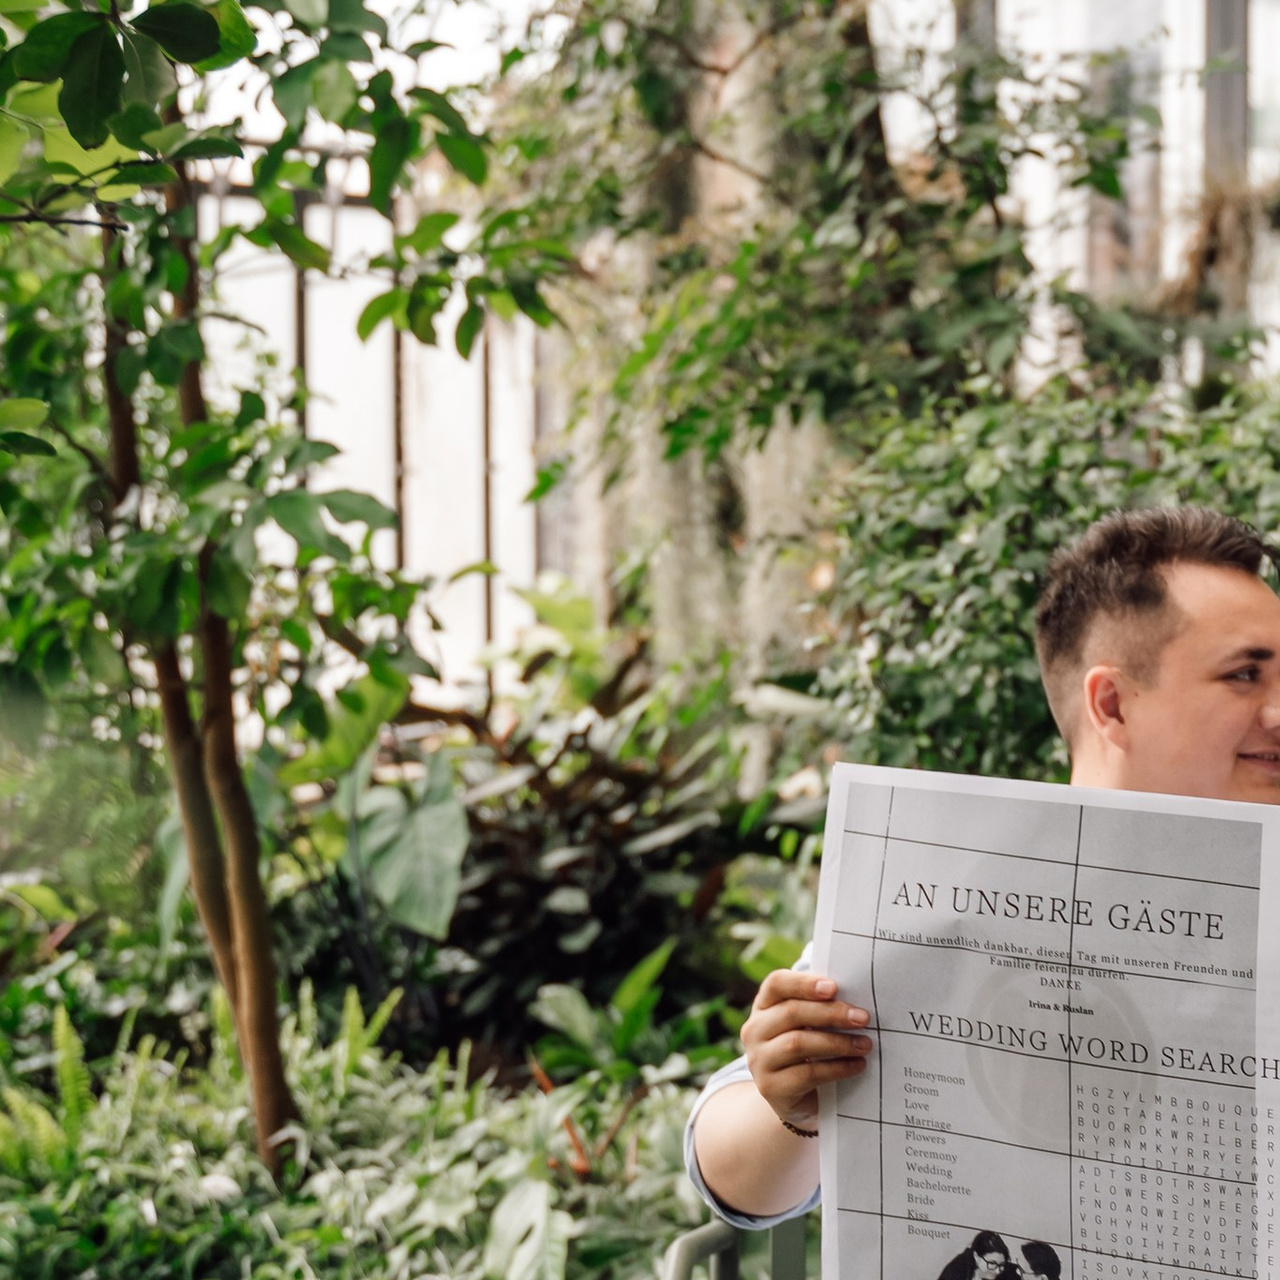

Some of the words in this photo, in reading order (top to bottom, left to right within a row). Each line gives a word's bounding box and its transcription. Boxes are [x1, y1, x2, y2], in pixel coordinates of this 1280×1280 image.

[891, 881, 938, 909] AN
[952, 886, 1093, 926] UNSERE
[1107, 899, 1225, 940] GÄSTE
[878, 928, 897, 941] Wir
[900, 932, 922, 944] sind
[926, 935, 980, 949] unendlich
[984, 940, 1033, 956] dankbar,
[1077, 950, 1097, 964] Tag
[1101, 954, 1120, 965] mit
[1124, 958, 1169, 970] unseren
[1173, 961, 1228, 977] Freunden
[1232, 968, 1254, 980] und
[989, 955, 1032, 970] Familie
[1040, 976, 1082, 991] DANKE
[1029, 1000, 1051, 1011] Irina
[1053, 1003, 1061, 1012] &
[1062, 1002, 1094, 1016] Ruslan
[908, 1011, 1048, 1052] WEDDING
[1058, 1033, 1149, 1064] WORD
[903, 1066, 966, 1086] Honeymoon
[903, 1082, 940, 1097] Groom
[904, 1098, 930, 1111] Love
[904, 1114, 952, 1131] Marriage
[905, 1130, 947, 1145] Flowers
[905, 1146, 958, 1164] Ceremony
[905, 1161, 953, 1179] Wedding
[906, 1177, 972, 1196] Bachelorette
[907, 1192, 935, 1206] Bride
[907, 1208, 930, 1222] Kiss
[907, 1224, 951, 1240] Bouquet
